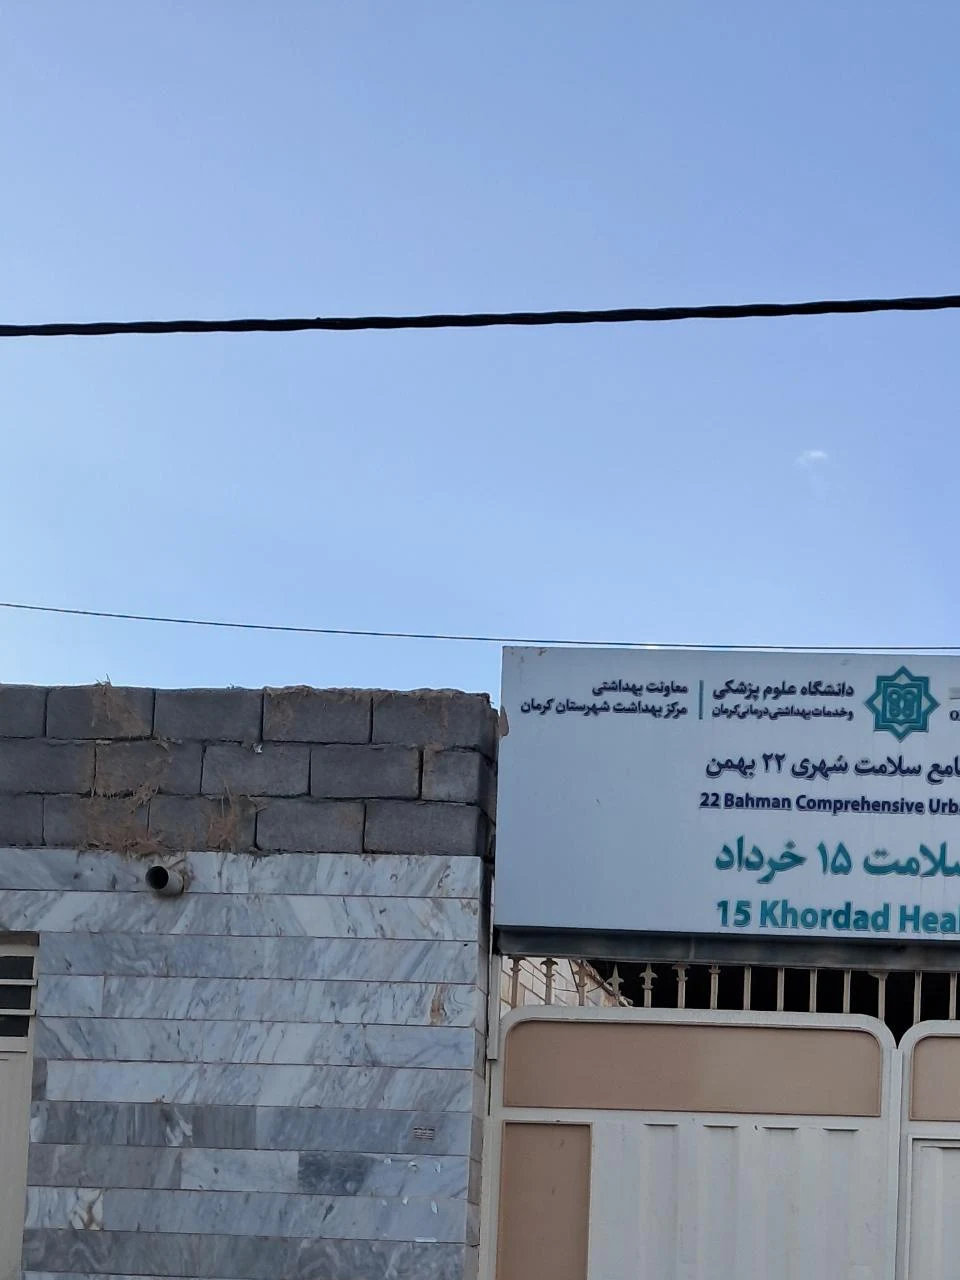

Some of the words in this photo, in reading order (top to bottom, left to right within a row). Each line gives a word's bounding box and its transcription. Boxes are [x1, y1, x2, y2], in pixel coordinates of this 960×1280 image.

[592, 679, 643, 697] بهداشتی
[646, 680, 688, 697] معاونت
[713, 679, 759, 702] پزشکی
[763, 681, 797, 700] علوم
[800, 681, 855, 697] دانشگاه
[520, 698, 554, 715] کرمان
[555, 699, 610, 716] شهرستان
[612, 700, 662, 718] بهداشت
[664, 701, 688, 719] مرکز
[712, 704, 740, 719] کرمان
[706, 756, 756, 779] بهمن
[762, 752, 786, 773] ۲۲
[791, 755, 849, 780] شهری
[854, 755, 922, 776] سلامت
[700, 792, 721, 808] 22
[724, 793, 792, 810] Bahman
[796, 795, 924, 816] Comprehensive
[715, 835, 807, 884] خرداد
[817, 841, 852, 876] ۱۵
[717, 900, 752, 927] 15
[760, 899, 891, 932] Khordad
